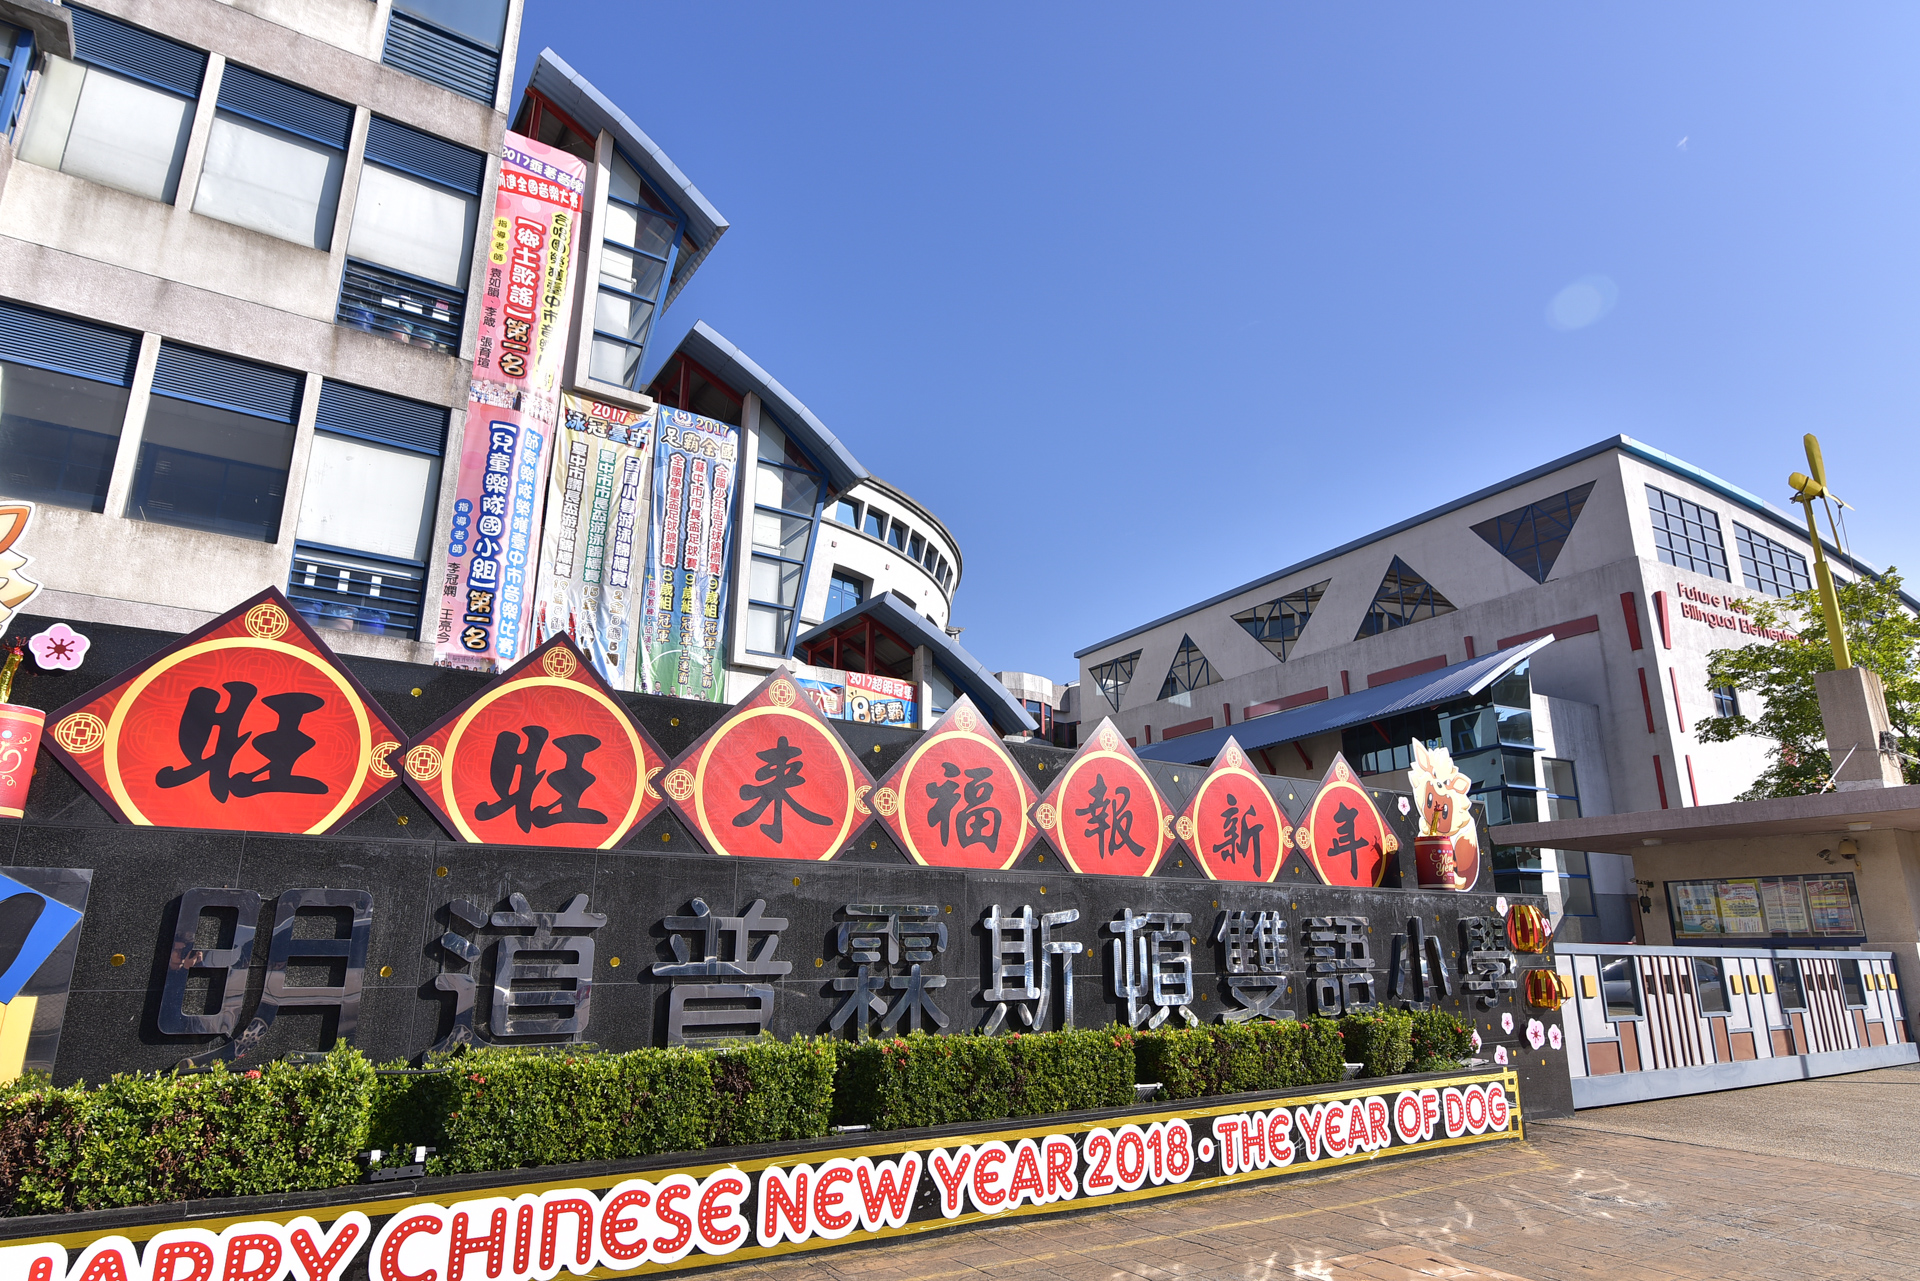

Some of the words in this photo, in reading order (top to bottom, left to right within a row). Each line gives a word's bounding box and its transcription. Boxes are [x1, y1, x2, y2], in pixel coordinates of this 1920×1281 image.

[593, 402, 628, 423] 2017
[696, 418, 729, 437] 2017
[1677, 582, 1721, 607] Future
[1681, 602, 1737, 631] Bilingual
[156, 681, 329, 804] 旺
[474, 725, 609, 834] 旺
[925, 761, 1002, 854] 福
[379, 1177, 744, 1281] CHINESE
[764, 1160, 916, 1239] NEW
[933, 1142, 1074, 1211] YEAR
[1087, 1125, 1189, 1188] 2018
[1217, 1113, 1291, 1169] THE
[1299, 1101, 1388, 1155] YEAR
[1397, 1093, 1437, 1138] OF
[1445, 1087, 1506, 1133] DOG
